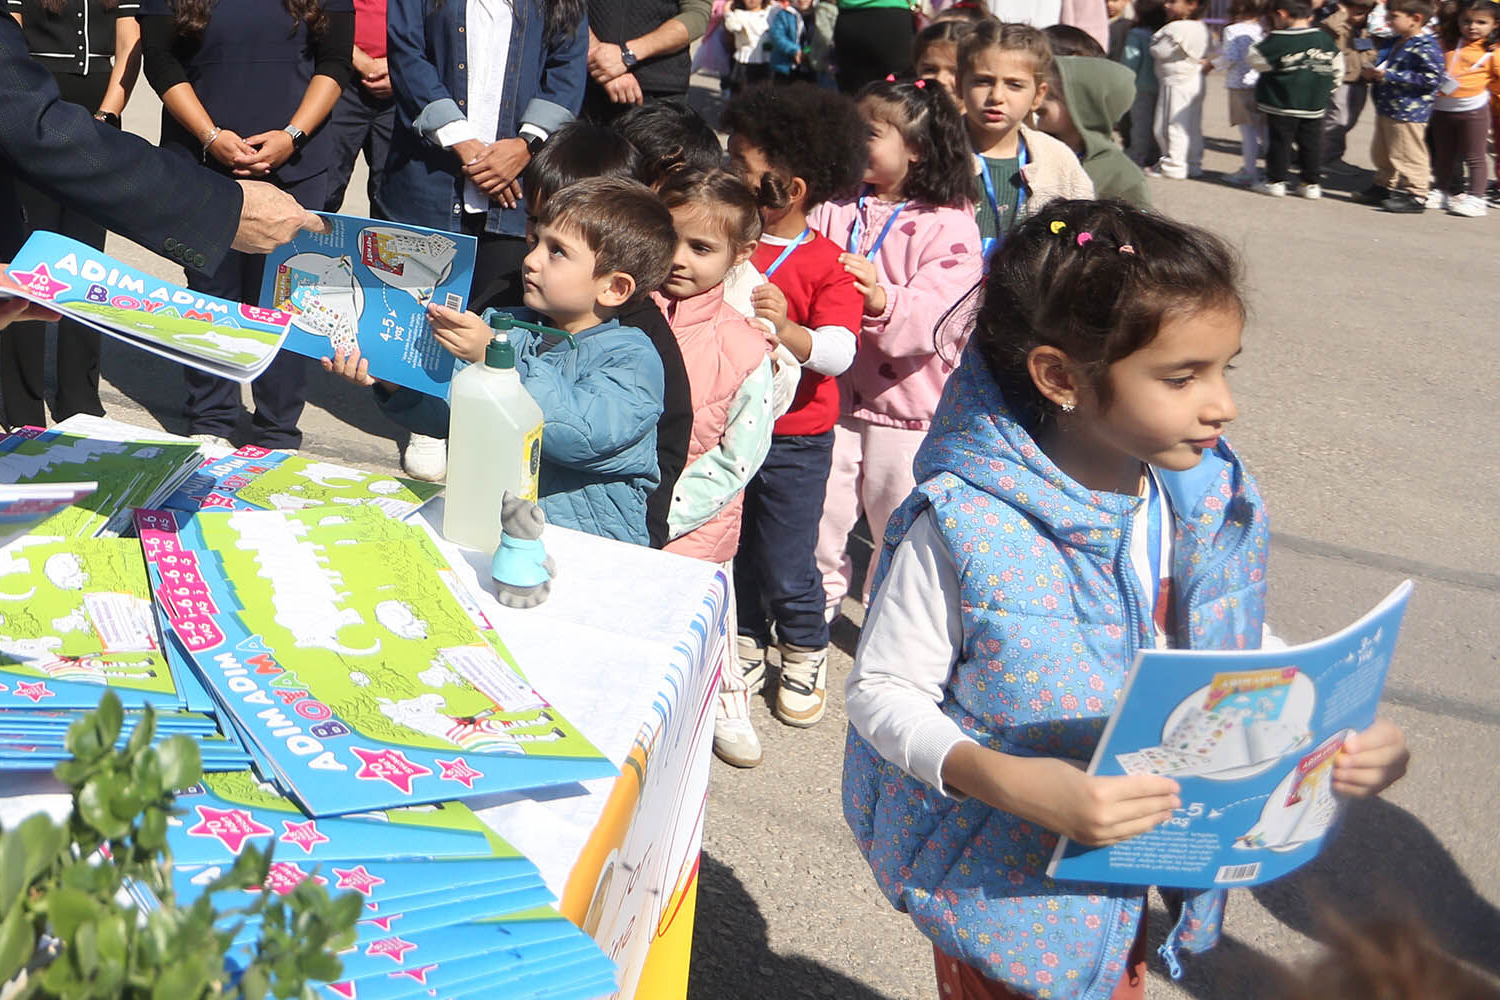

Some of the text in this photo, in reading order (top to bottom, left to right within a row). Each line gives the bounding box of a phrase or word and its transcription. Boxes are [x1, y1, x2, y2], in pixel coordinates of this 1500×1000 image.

[33, 272, 49, 285] 70
[54, 252, 228, 314] ADIM ADIM
[85, 283, 242, 329] BOYAMA
[249, 306, 283, 319] 5-6
[380, 317, 396, 343] 4-5
[208, 458, 249, 478] ADIM
[179, 621, 206, 646] 5-6
[236, 633, 352, 739] BOYAMA
[213, 652, 349, 771] ADIM ADIM
[368, 761, 391, 776] 70
[1172, 802, 1205, 817] -5
[205, 820, 227, 833] 70
